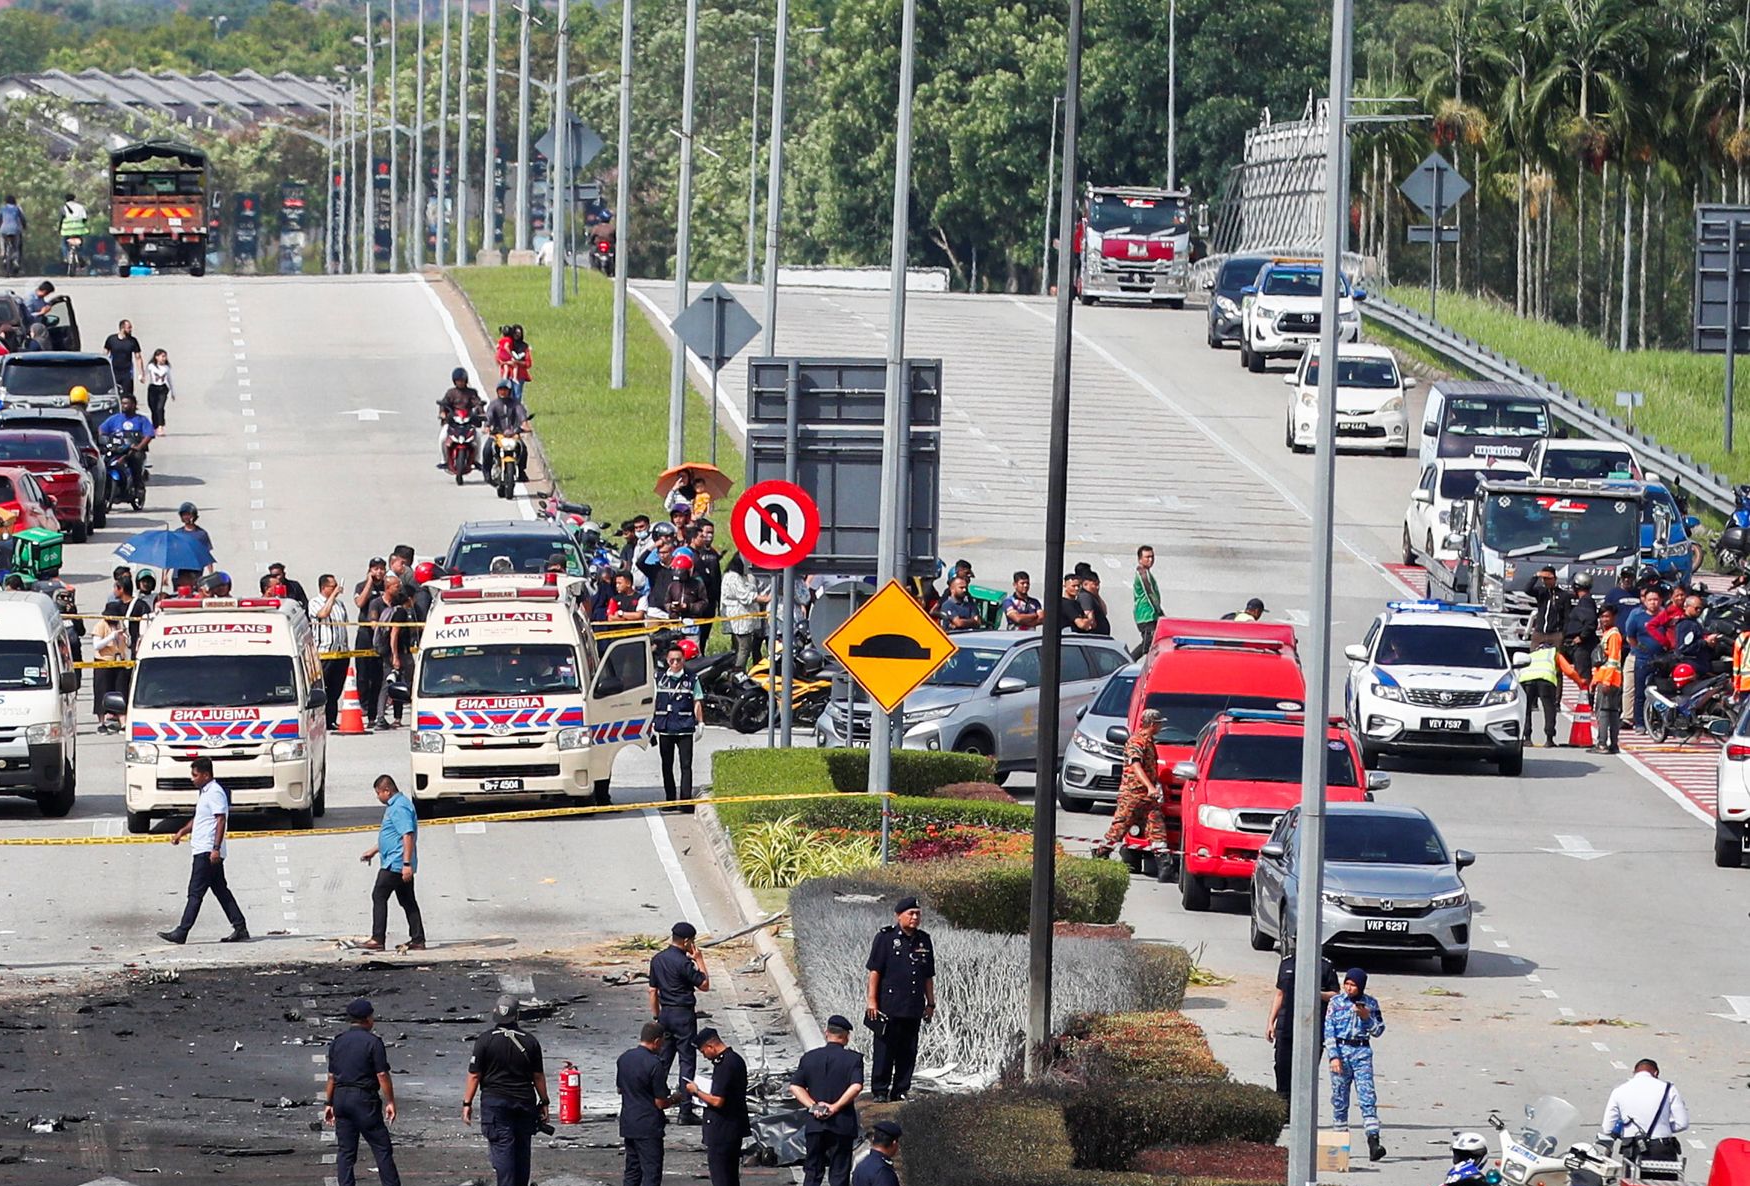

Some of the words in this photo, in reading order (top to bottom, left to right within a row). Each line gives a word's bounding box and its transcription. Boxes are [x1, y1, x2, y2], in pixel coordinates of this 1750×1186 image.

[450, 612, 548, 624] AMBULANS
[169, 624, 268, 635] AMBULANS
[435, 627, 470, 640] KKM
[151, 638, 187, 651] KKM
[1366, 920, 1385, 932] VKP
[1386, 920, 1408, 932] 6297
